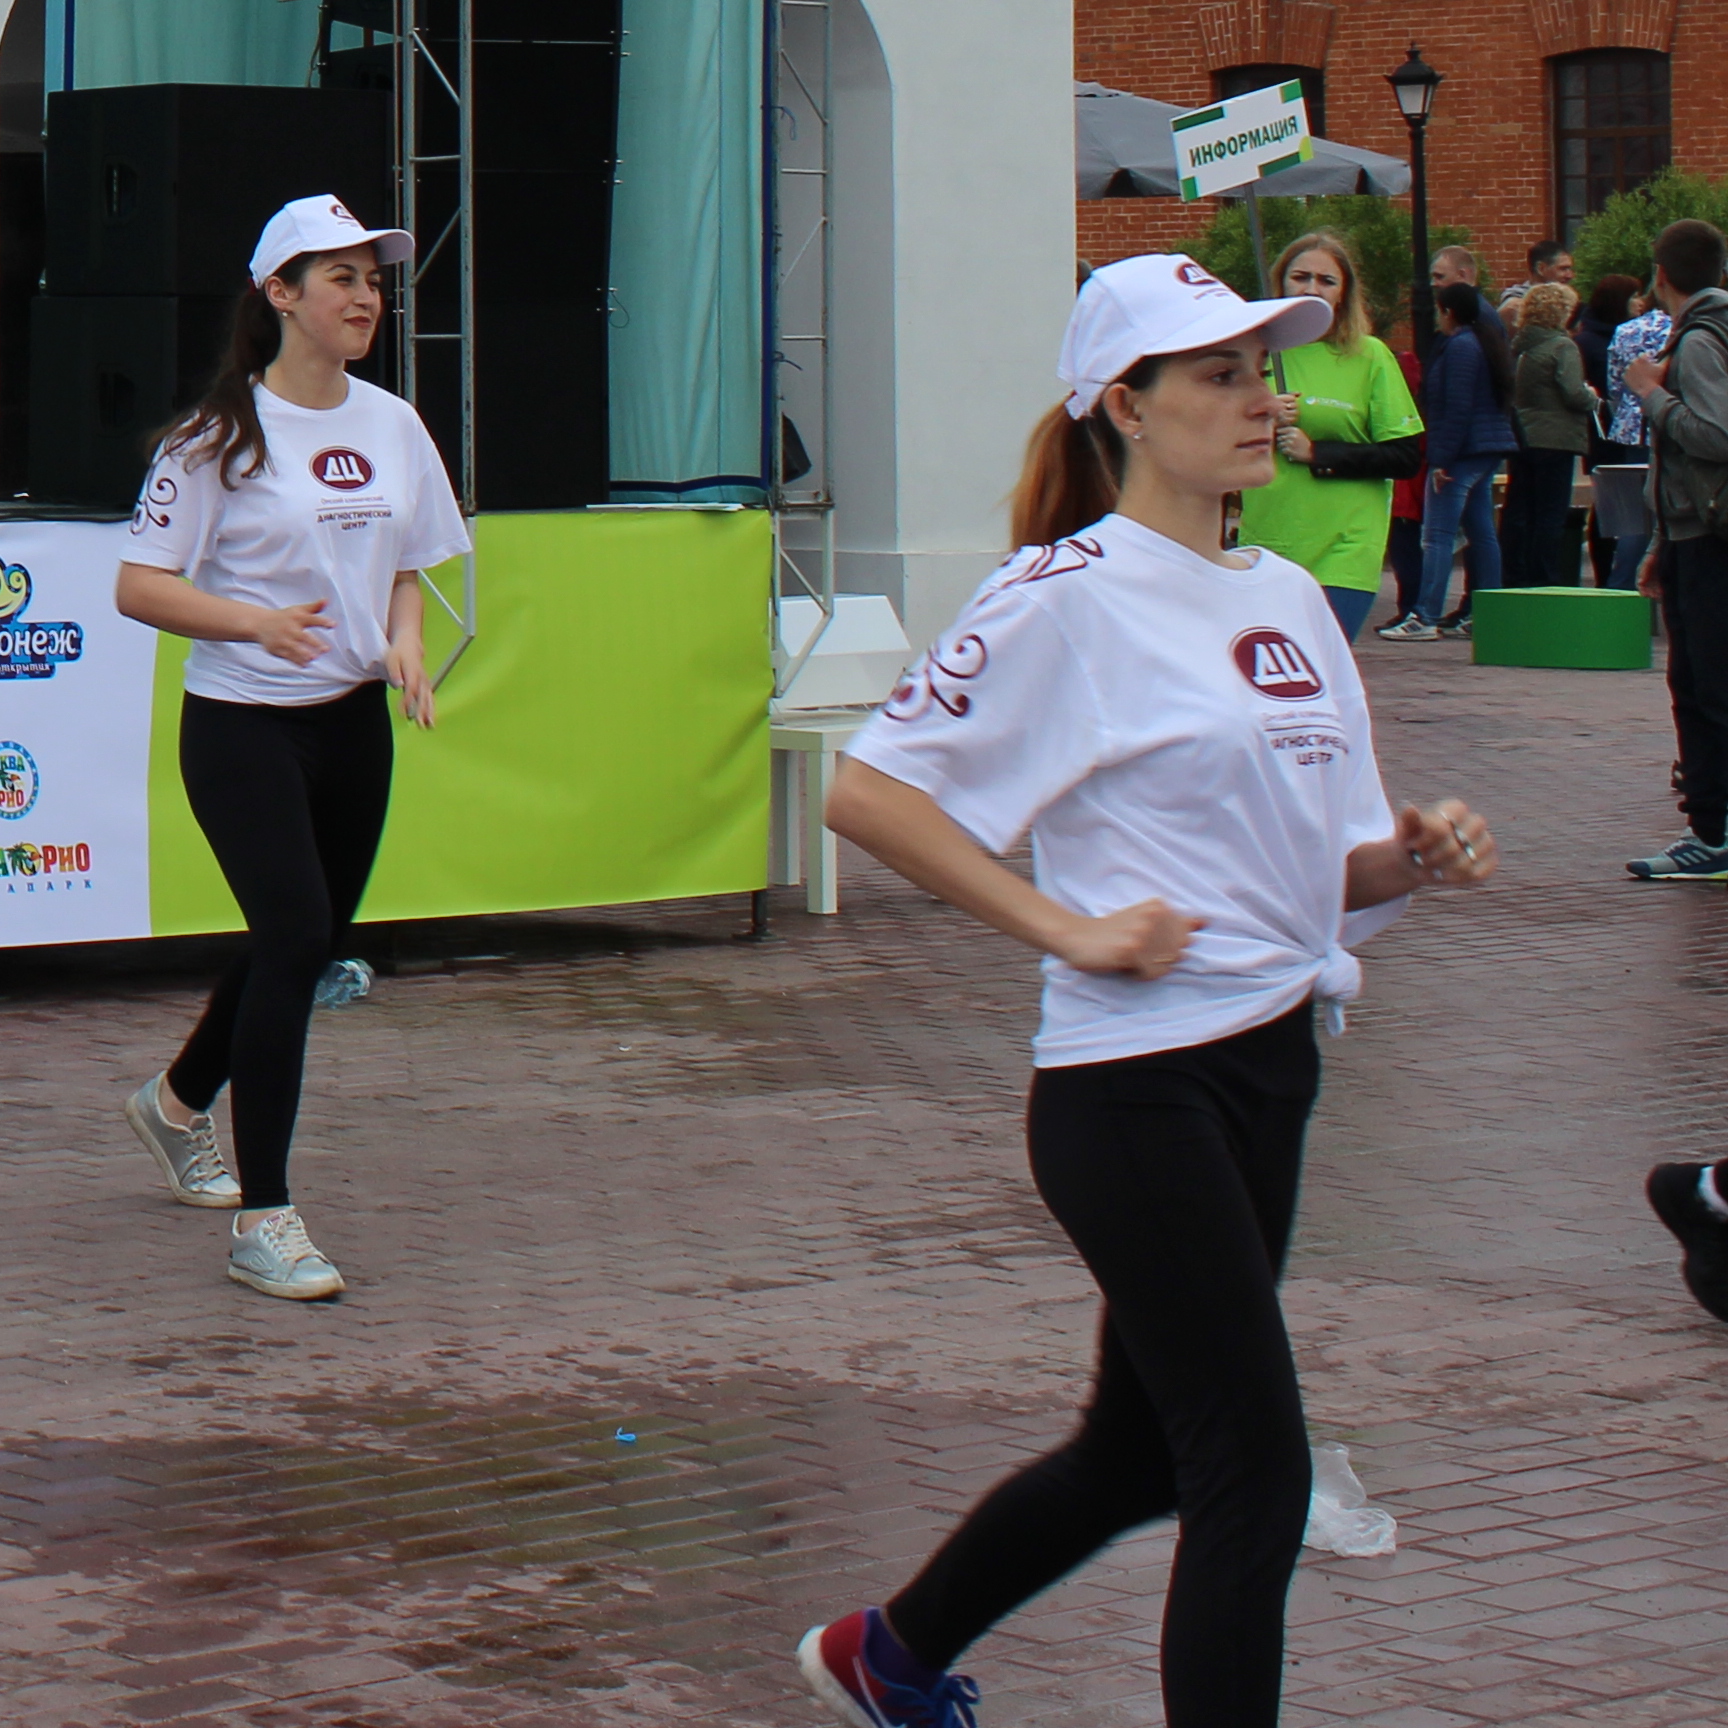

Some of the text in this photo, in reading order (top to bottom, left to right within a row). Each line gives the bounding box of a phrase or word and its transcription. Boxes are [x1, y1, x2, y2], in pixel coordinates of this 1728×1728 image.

[1188, 115, 1299, 168] ИНФОРМАЦИЯ
[322, 455, 366, 483] ДЦ
[1252, 641, 1319, 687] ДЦ
